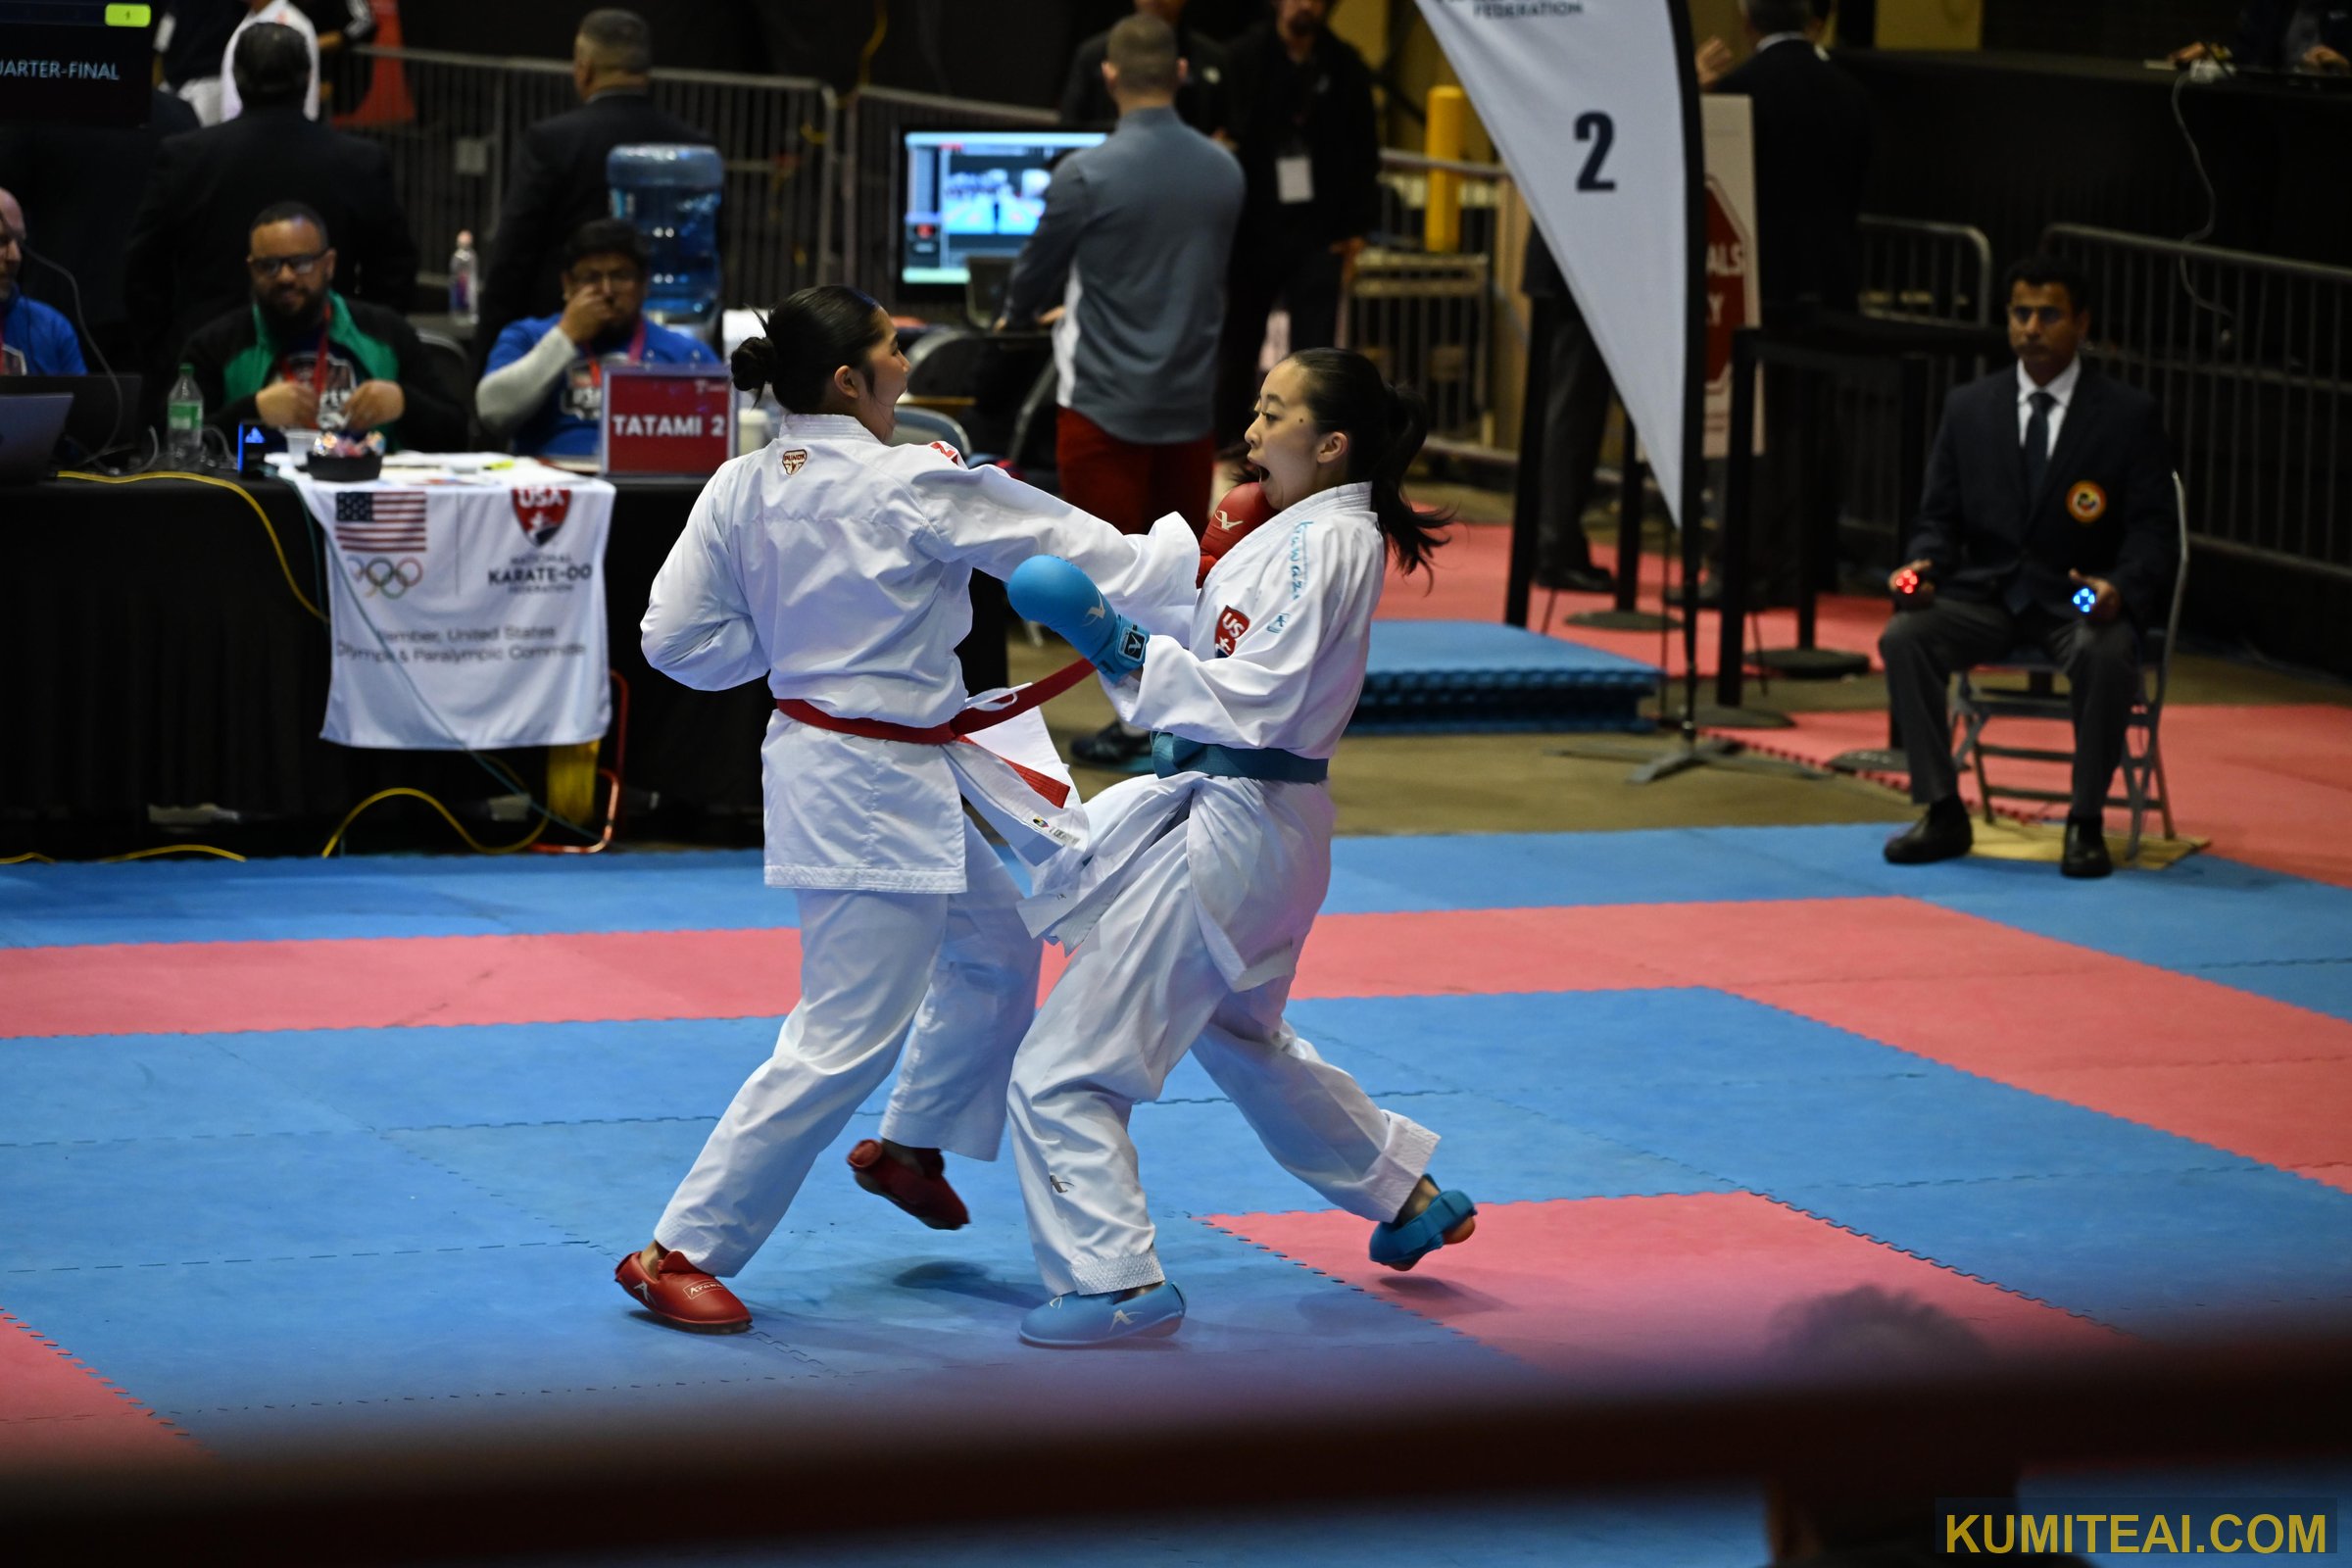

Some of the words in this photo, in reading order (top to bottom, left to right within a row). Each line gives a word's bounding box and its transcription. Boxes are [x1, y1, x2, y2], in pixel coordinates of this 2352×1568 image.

[1473, 1, 1583, 19] FEDERATION
[0, 59, 120, 80] ARTER-FINAL
[1574, 110, 1616, 192] 2
[612, 414, 703, 436] TATAMI
[710, 415, 726, 436] 2
